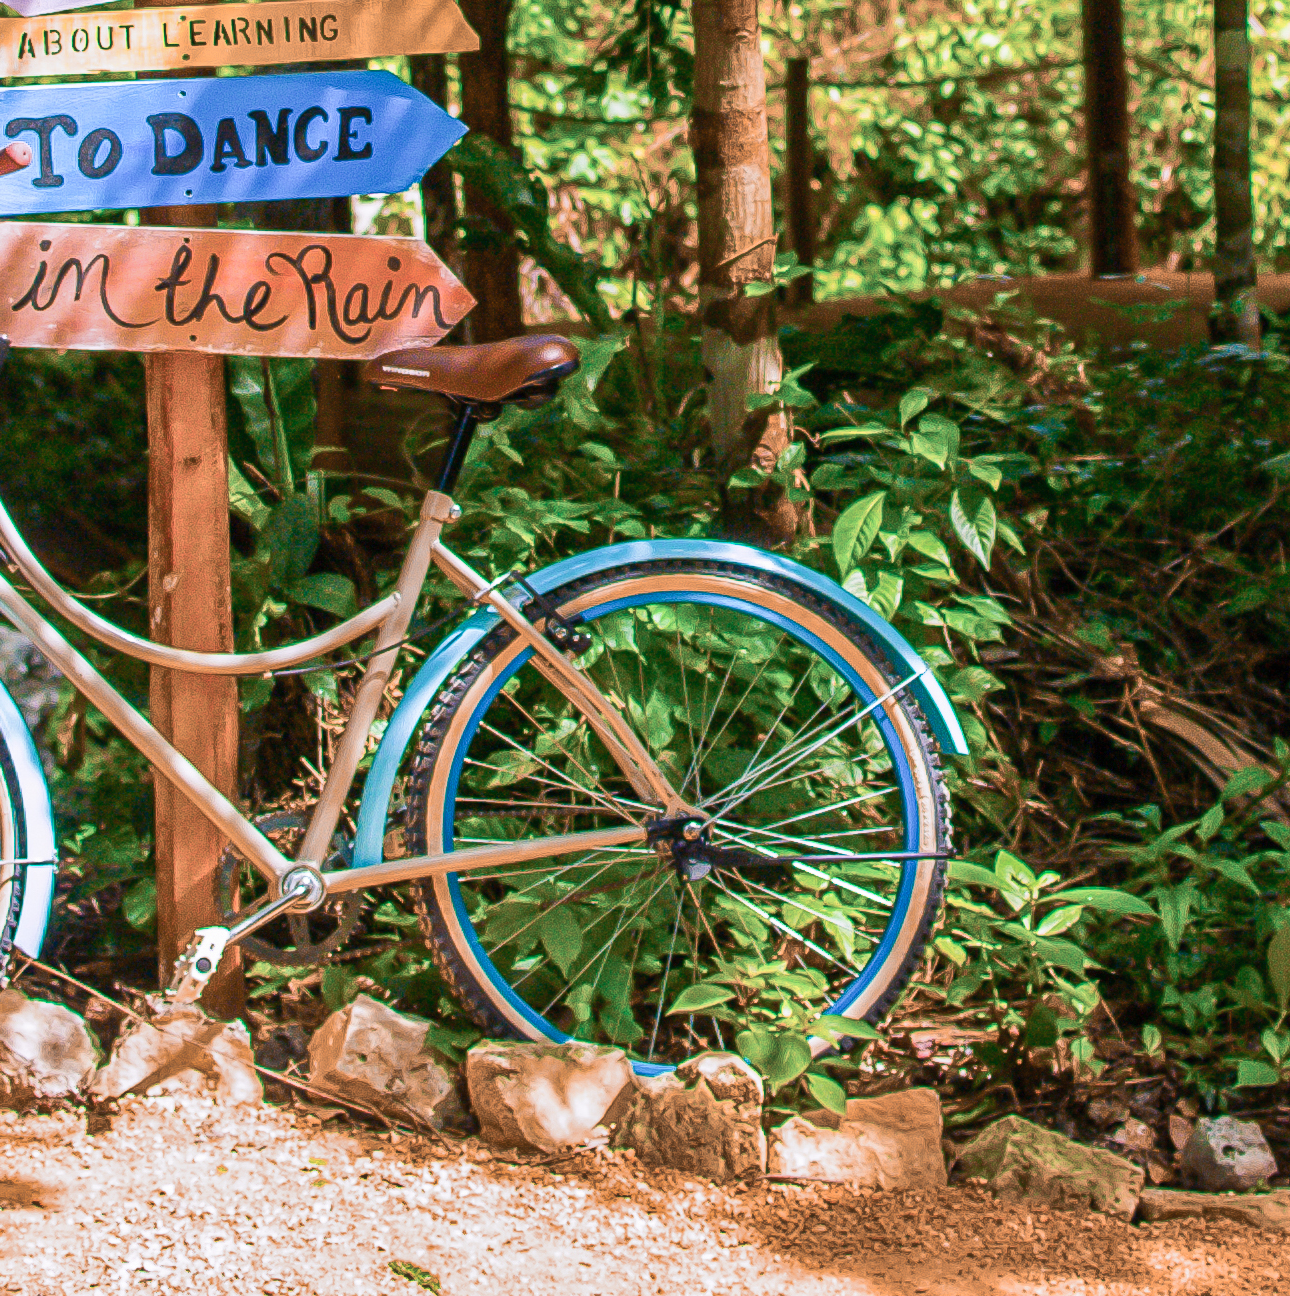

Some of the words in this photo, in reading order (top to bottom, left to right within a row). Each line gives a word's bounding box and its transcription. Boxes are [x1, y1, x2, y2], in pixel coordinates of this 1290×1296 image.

[17, 23, 136, 60] ABOUT
[162, 14, 340, 50] LEARNING
[147, 106, 375, 176] DANCE
[11, 240, 163, 330] in
[155, 244, 287, 332] the
[265, 244, 455, 345] Rain
